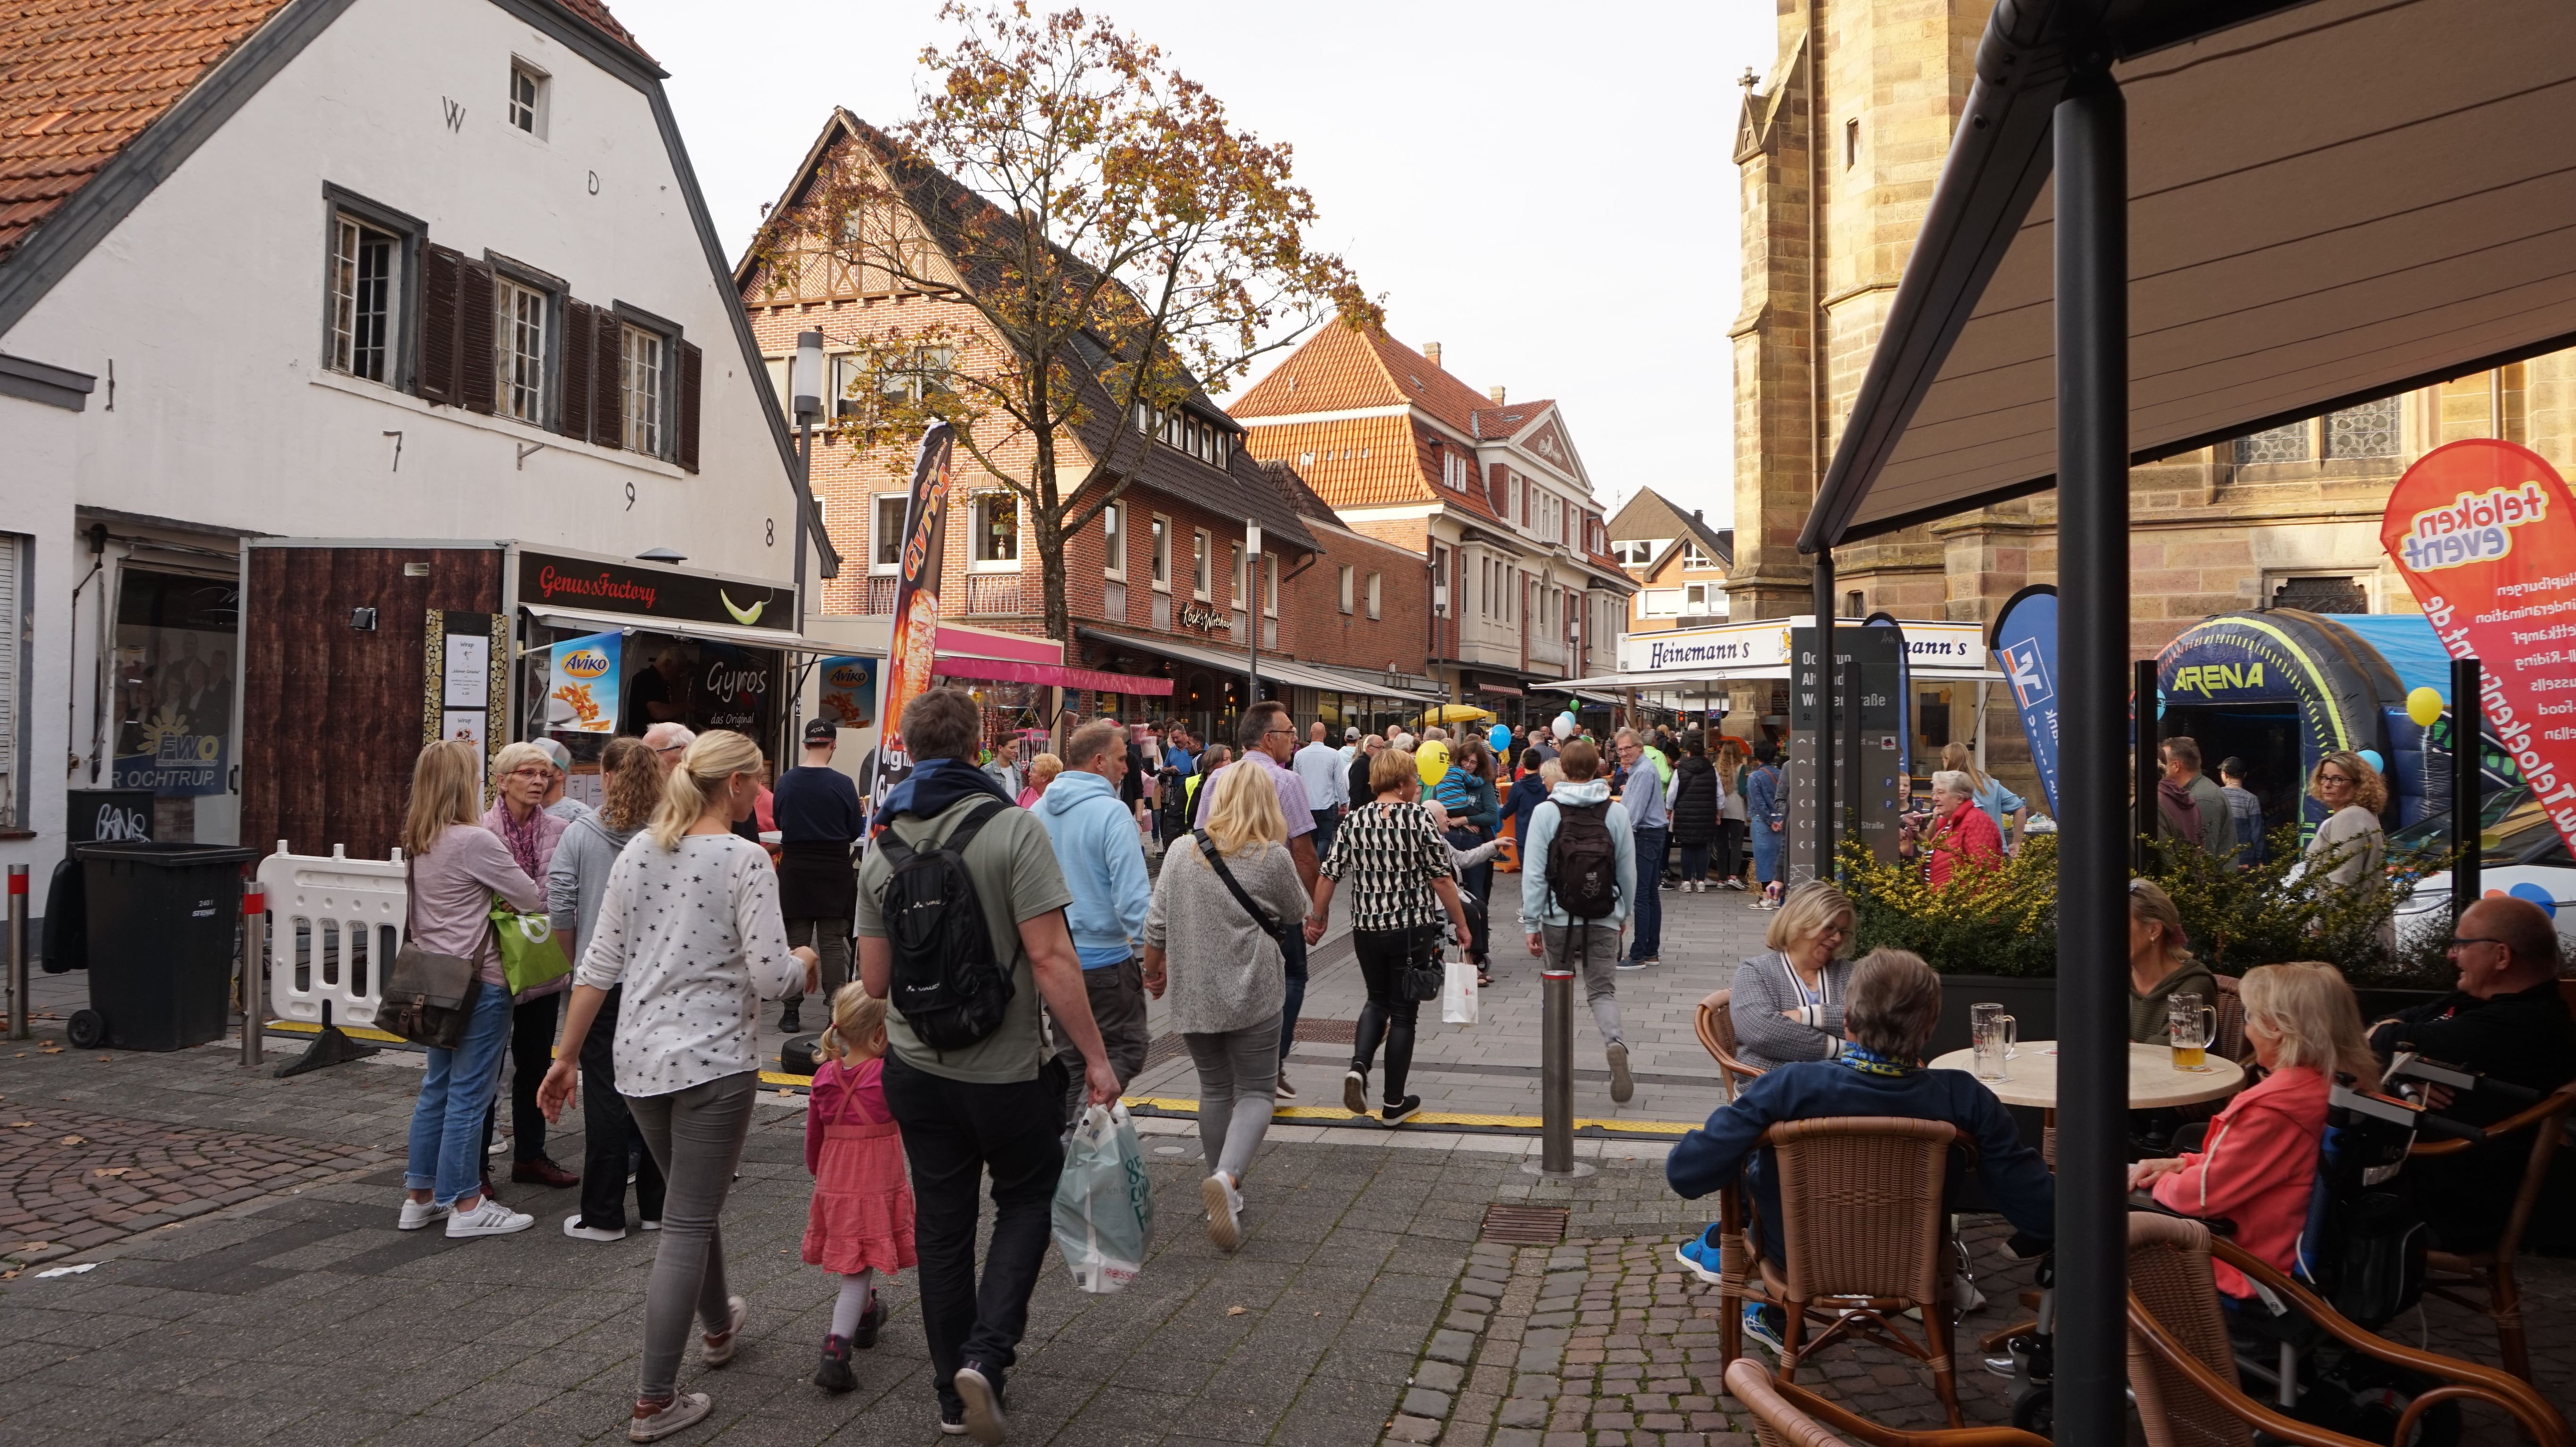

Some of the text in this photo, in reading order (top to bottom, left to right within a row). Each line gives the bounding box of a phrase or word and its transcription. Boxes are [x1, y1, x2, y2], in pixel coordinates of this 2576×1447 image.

[442, 95, 600, 196] W D
[382, 430, 403, 472] 7
[625, 481, 636, 512] 9
[766, 518, 774, 547] 8
[904, 462, 949, 582] Gyros
[540, 565, 656, 609] GenussFactory
[1184, 602, 1232, 632] Kock's Wirtshaus
[707, 661, 767, 703] Gyros
[2173, 662, 2264, 699] ARENA
[726, 712, 754, 725] Original
[156, 735, 219, 761] FWO
[127, 771, 215, 787] OCHTRUP.
